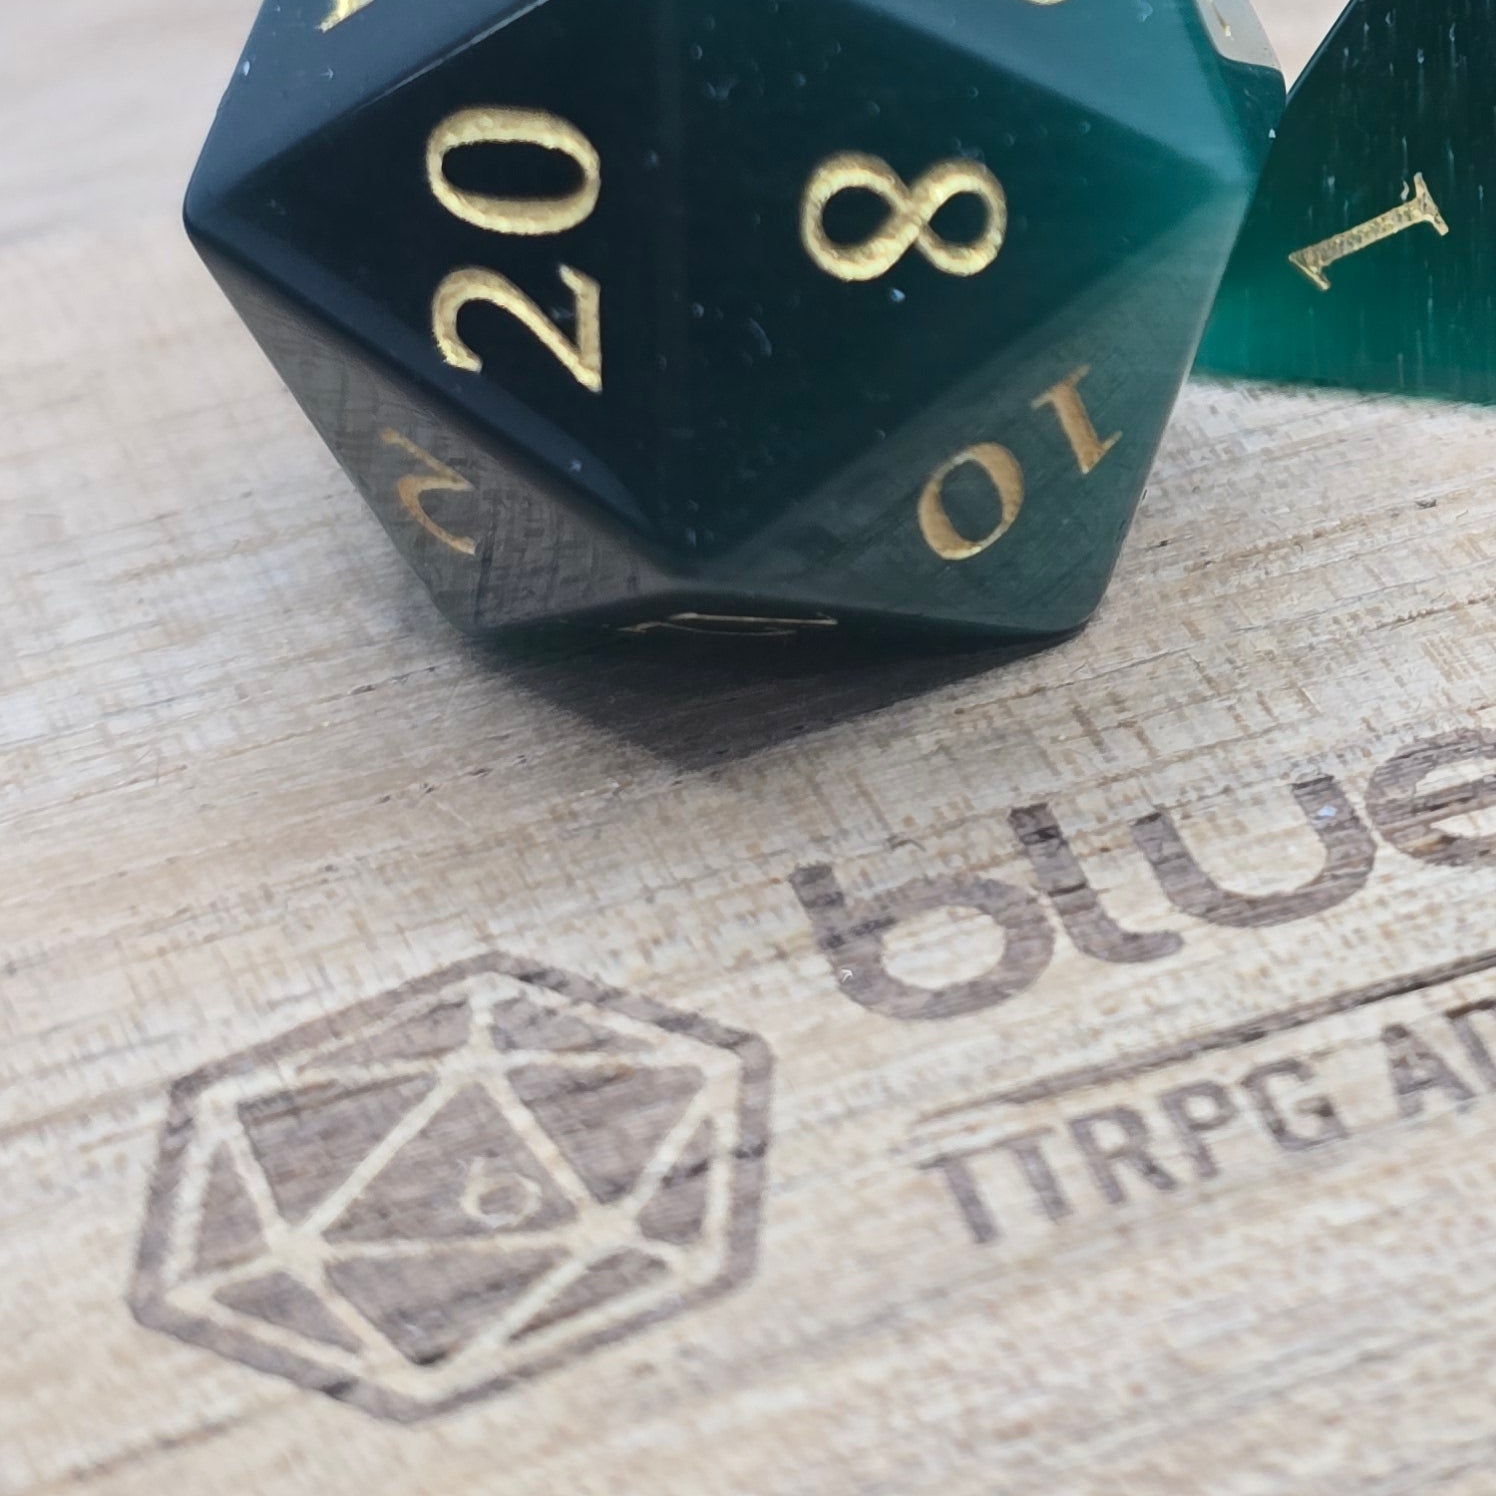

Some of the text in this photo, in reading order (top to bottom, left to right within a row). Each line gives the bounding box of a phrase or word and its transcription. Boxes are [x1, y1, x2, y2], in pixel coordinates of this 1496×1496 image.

[424, 105, 601, 393] 20
[801, 152, 1008, 281] 8
[1288, 172, 1449, 292] 1
[917, 365, 1123, 562] 10
[915, 1057, 1351, 1246] TTRPG
